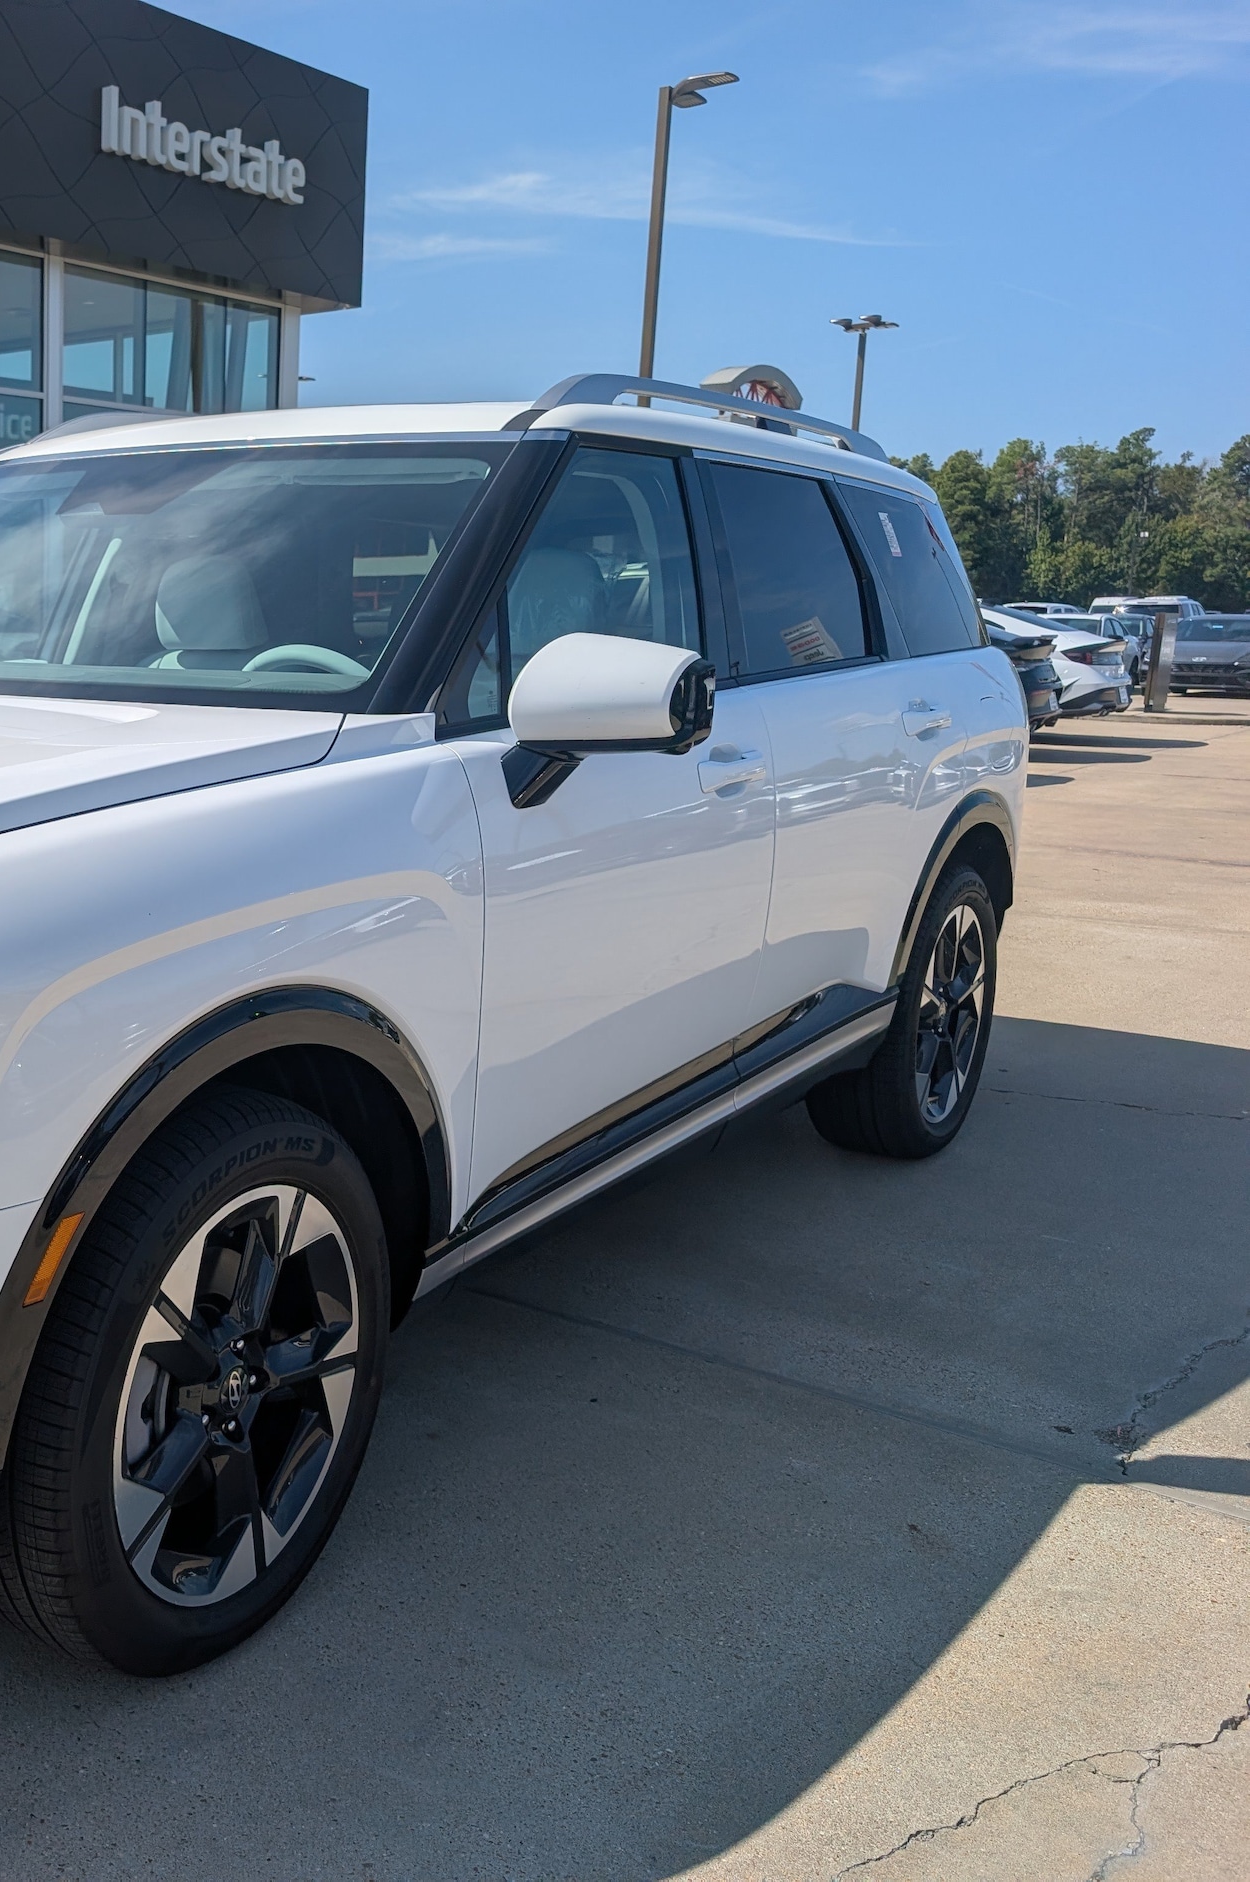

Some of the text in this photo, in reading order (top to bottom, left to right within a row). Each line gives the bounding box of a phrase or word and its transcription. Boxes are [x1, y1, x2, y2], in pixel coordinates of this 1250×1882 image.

[101, 85, 306, 205] Interstate
[161, 1136, 316, 1247] SCORPION MS
